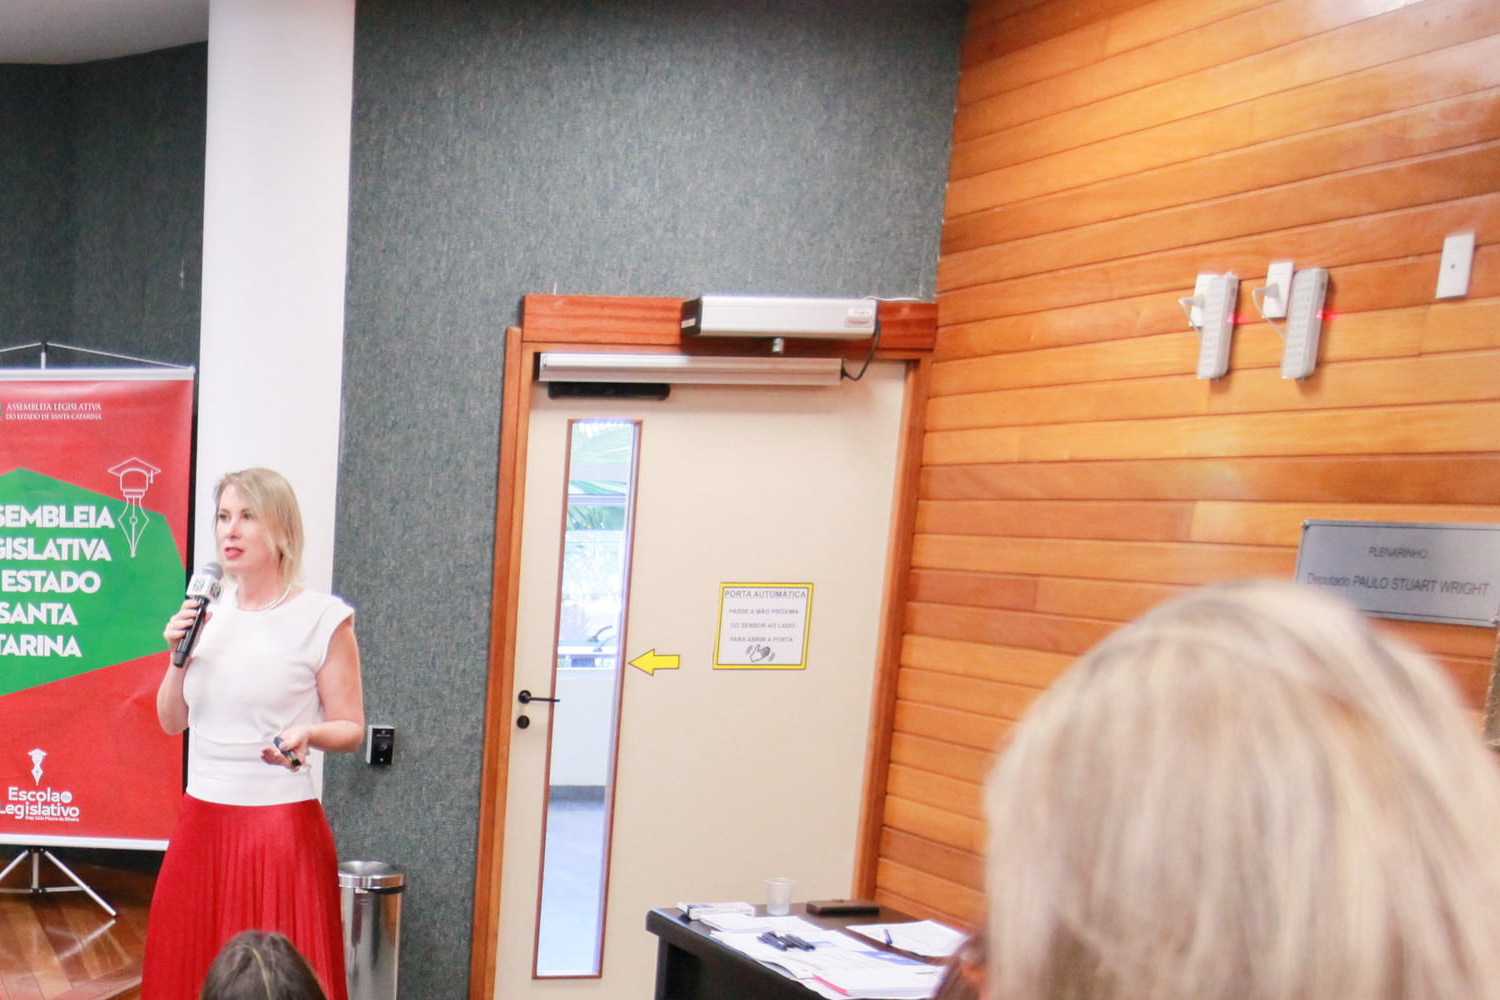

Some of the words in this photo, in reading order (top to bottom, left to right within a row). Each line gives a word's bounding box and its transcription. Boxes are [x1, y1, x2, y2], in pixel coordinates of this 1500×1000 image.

[7, 403, 52, 411] ASSEMBLEIA
[54, 403, 102, 411] LEGISLATIVA
[1, 570, 101, 593] ESTADO
[1307, 573, 1350, 587] Deputado
[1352, 576, 1388, 590] PAULO
[1391, 578, 1436, 592] STUART
[1440, 582, 1489, 595] WRIGHT
[8, 787, 60, 801] Escola
